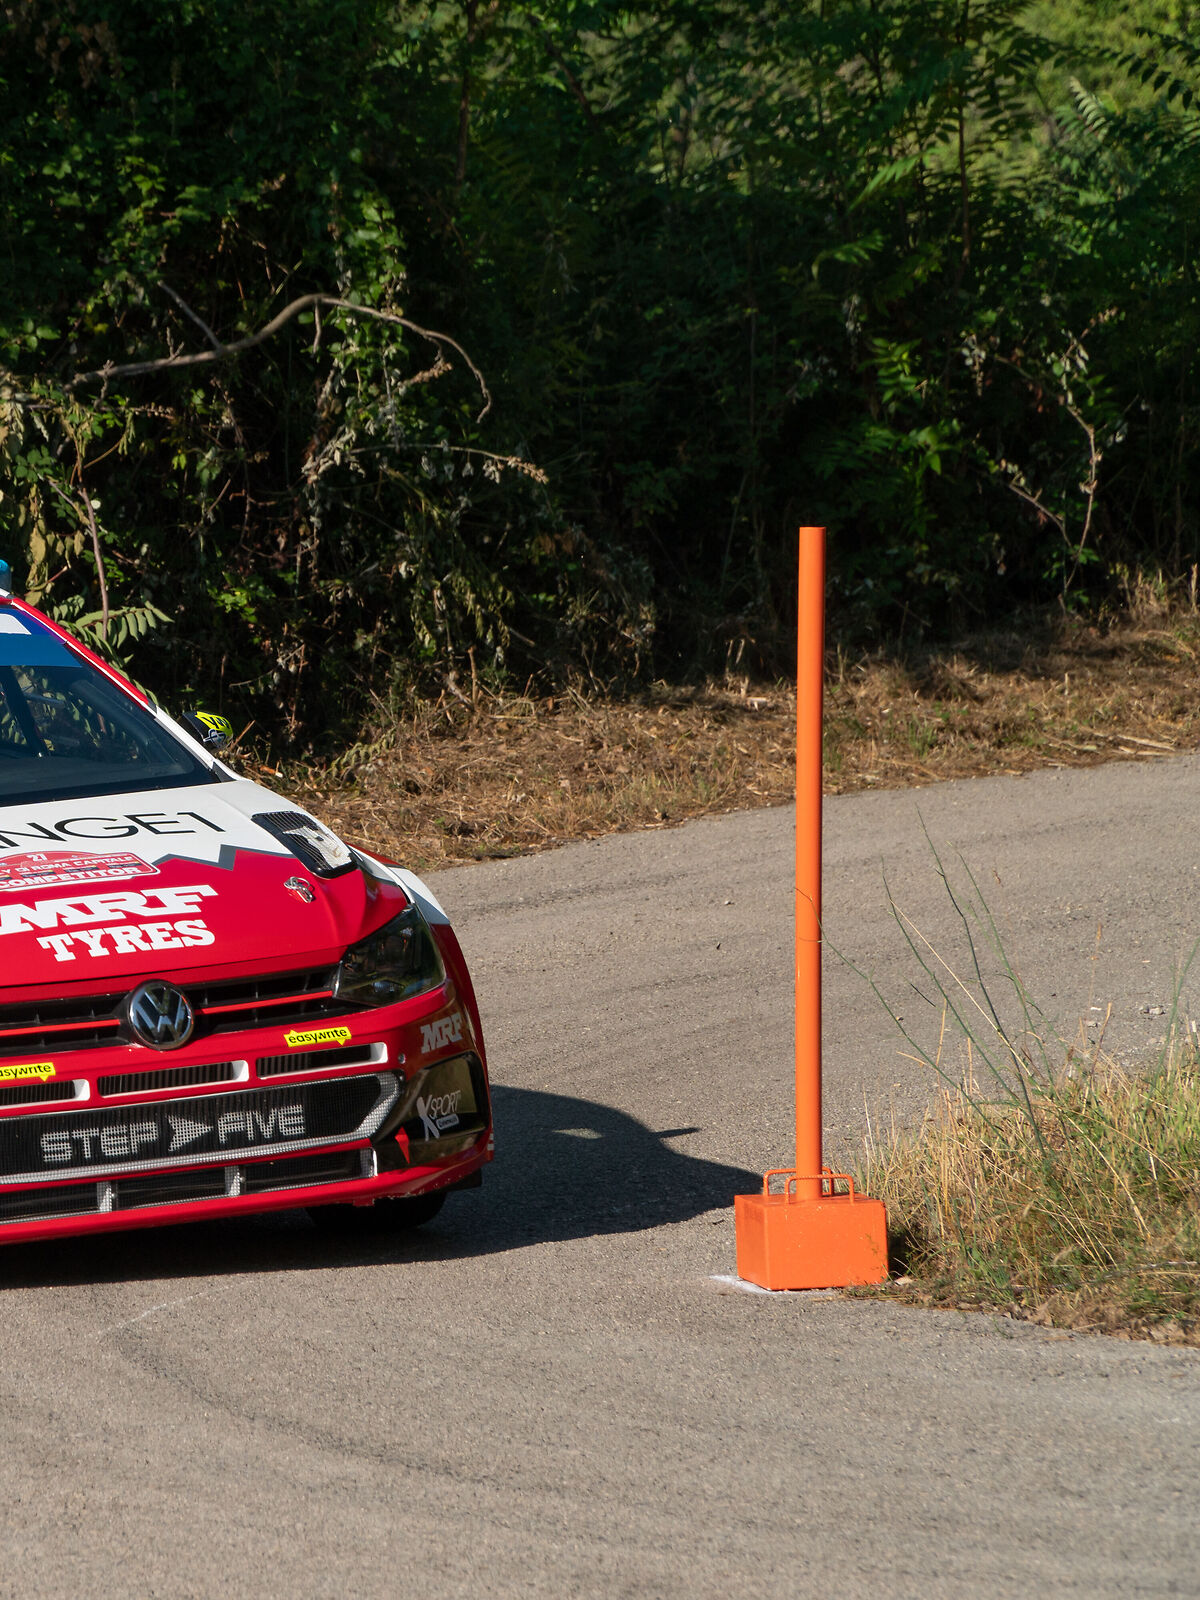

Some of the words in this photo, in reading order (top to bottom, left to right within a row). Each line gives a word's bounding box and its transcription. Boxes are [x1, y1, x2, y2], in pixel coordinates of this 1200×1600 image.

[26, 853, 48, 862] 27
[32, 861, 69, 871] ROMA
[74, 856, 133, 867] CAPITALE
[36, 919, 215, 962] TYRES
[288, 1027, 348, 1045] easywrite
[420, 1012, 463, 1054] MRF
[40, 1121, 159, 1163] STEP
[217, 1104, 305, 1145] FIVE
